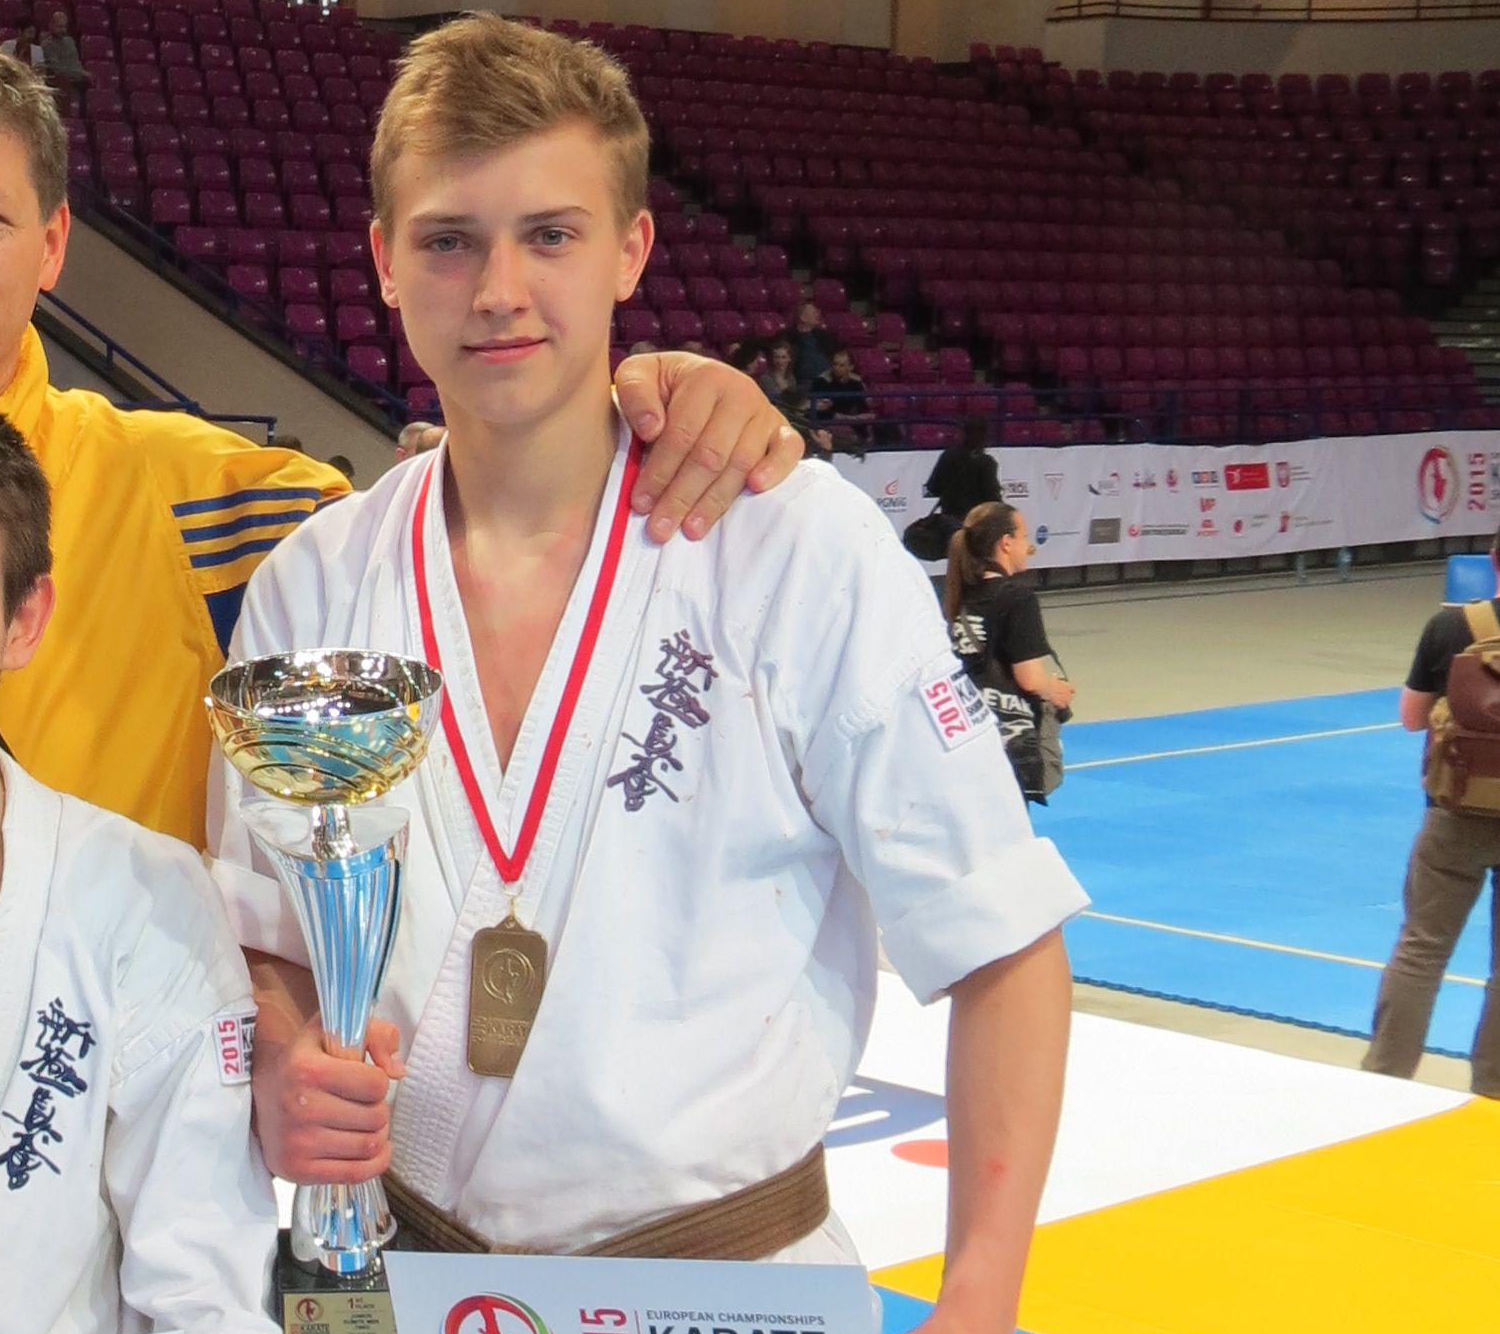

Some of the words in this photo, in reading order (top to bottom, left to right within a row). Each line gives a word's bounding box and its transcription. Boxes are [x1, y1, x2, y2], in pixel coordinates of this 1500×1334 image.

[925, 681, 967, 738] 2015
[218, 1019, 240, 1075] 2015
[646, 1309, 715, 1323] EUROPEAN
[718, 1312, 825, 1326] CHAMPIONSHIPS
